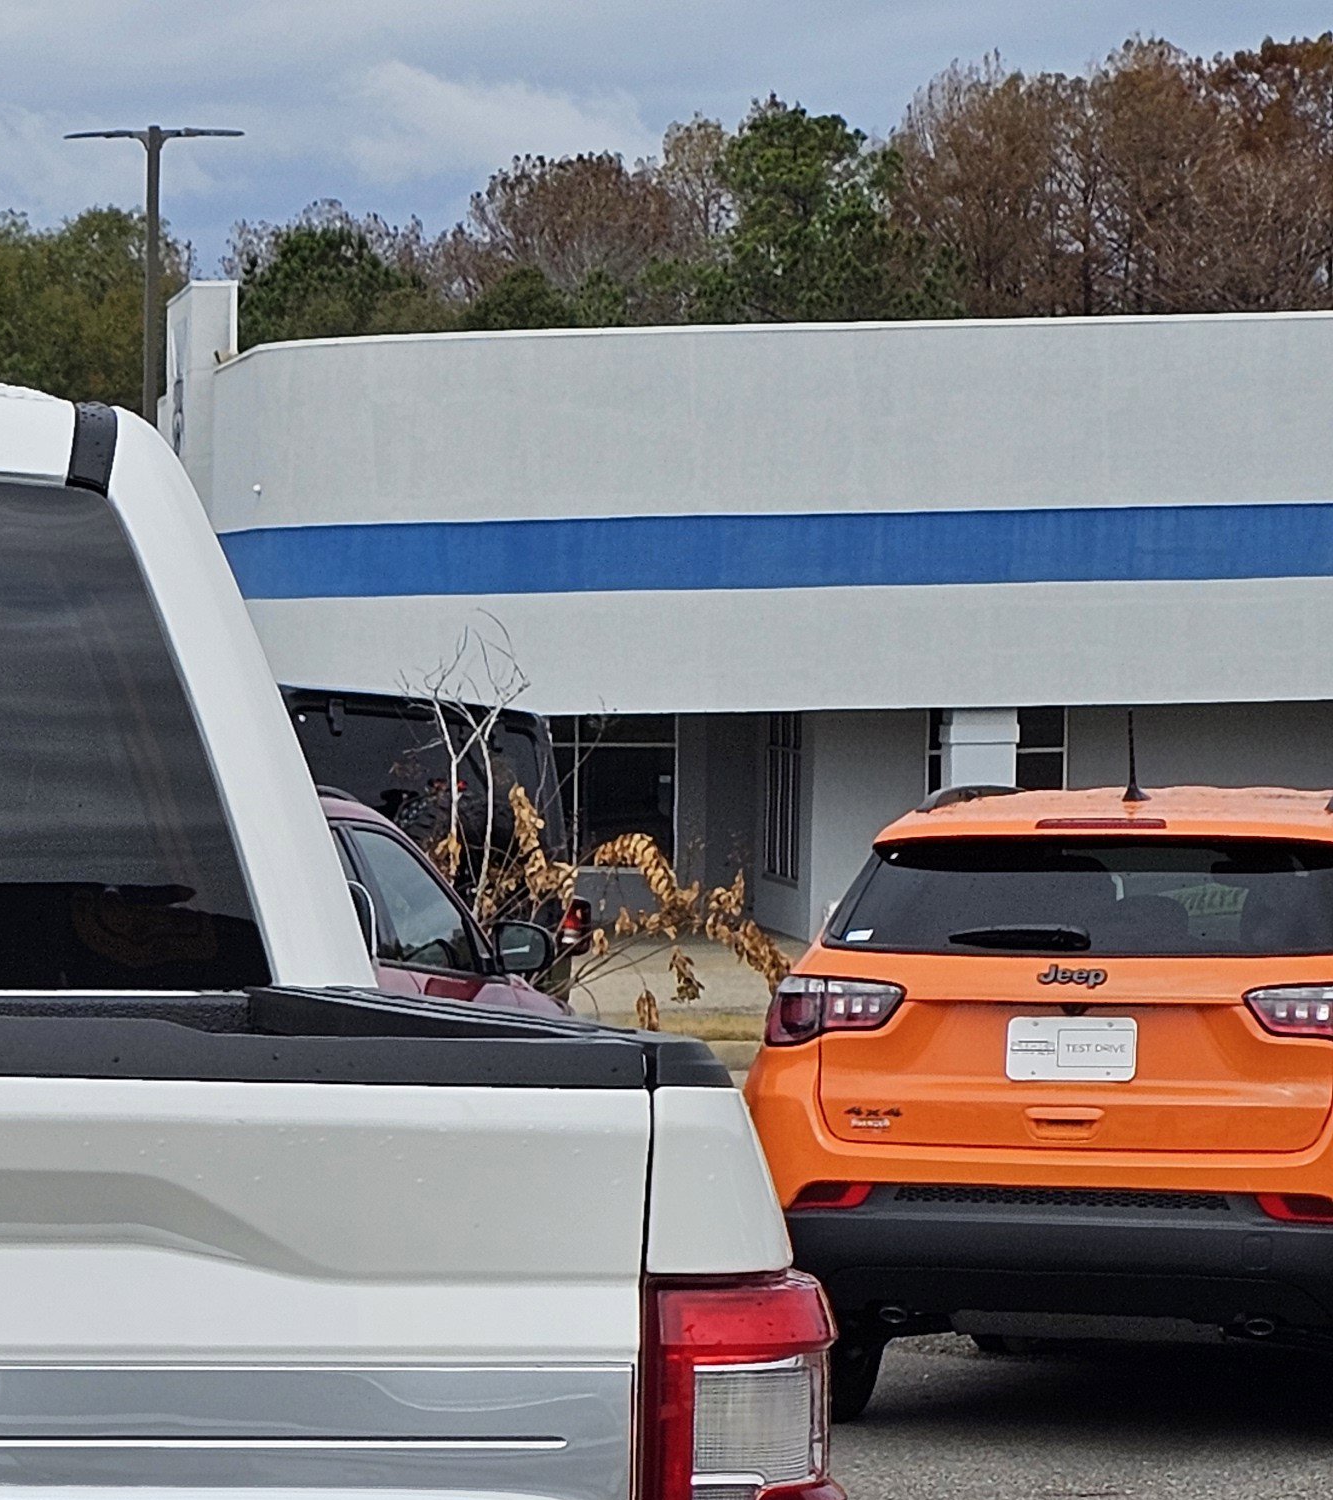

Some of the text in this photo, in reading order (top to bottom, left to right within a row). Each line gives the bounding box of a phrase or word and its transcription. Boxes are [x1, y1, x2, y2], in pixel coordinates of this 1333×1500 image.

[1037, 963, 1108, 989] Jeep
[1066, 1043, 1091, 1053] TEST
[1095, 1043, 1126, 1053] DRIVE
